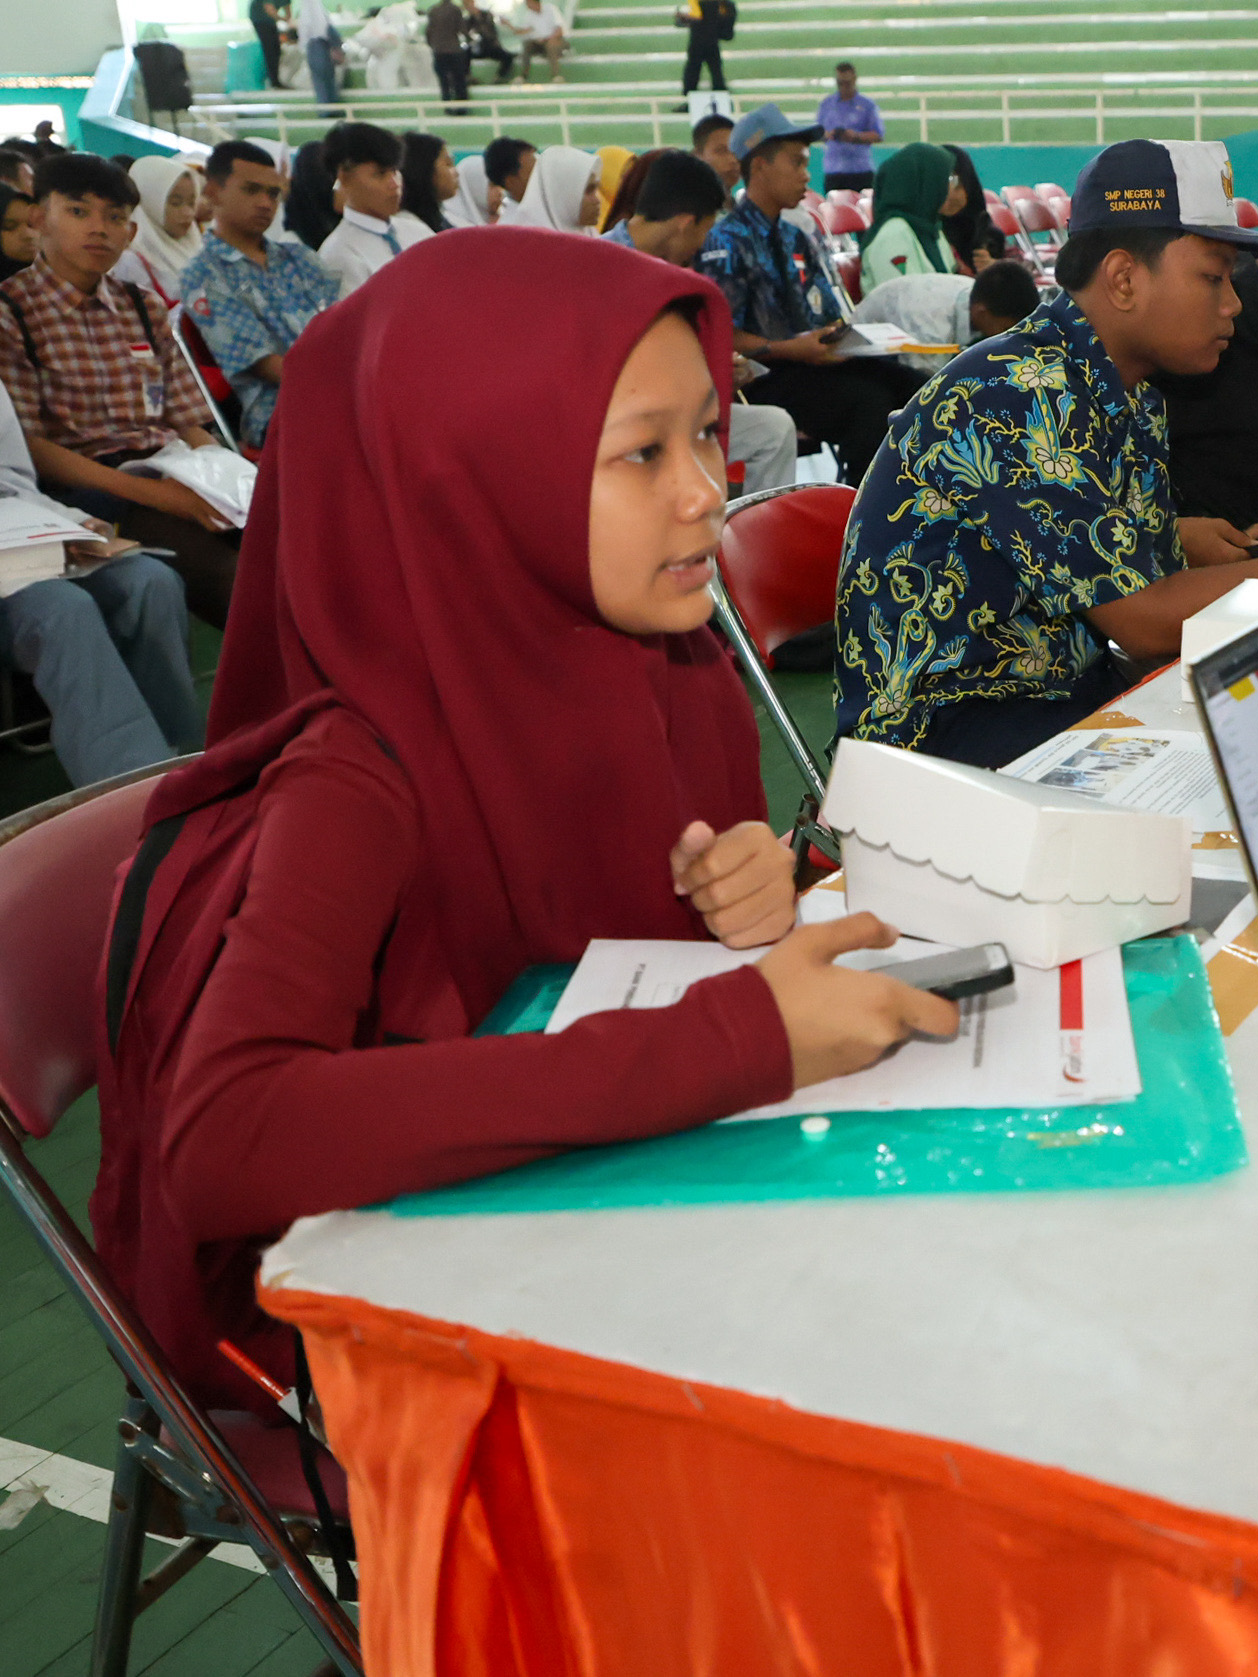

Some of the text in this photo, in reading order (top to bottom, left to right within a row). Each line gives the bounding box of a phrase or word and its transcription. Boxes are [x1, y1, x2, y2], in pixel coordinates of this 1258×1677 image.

[1105, 189, 1165, 200] SMP NEGERI 38
[1110, 200, 1161, 211] SURABAYA
